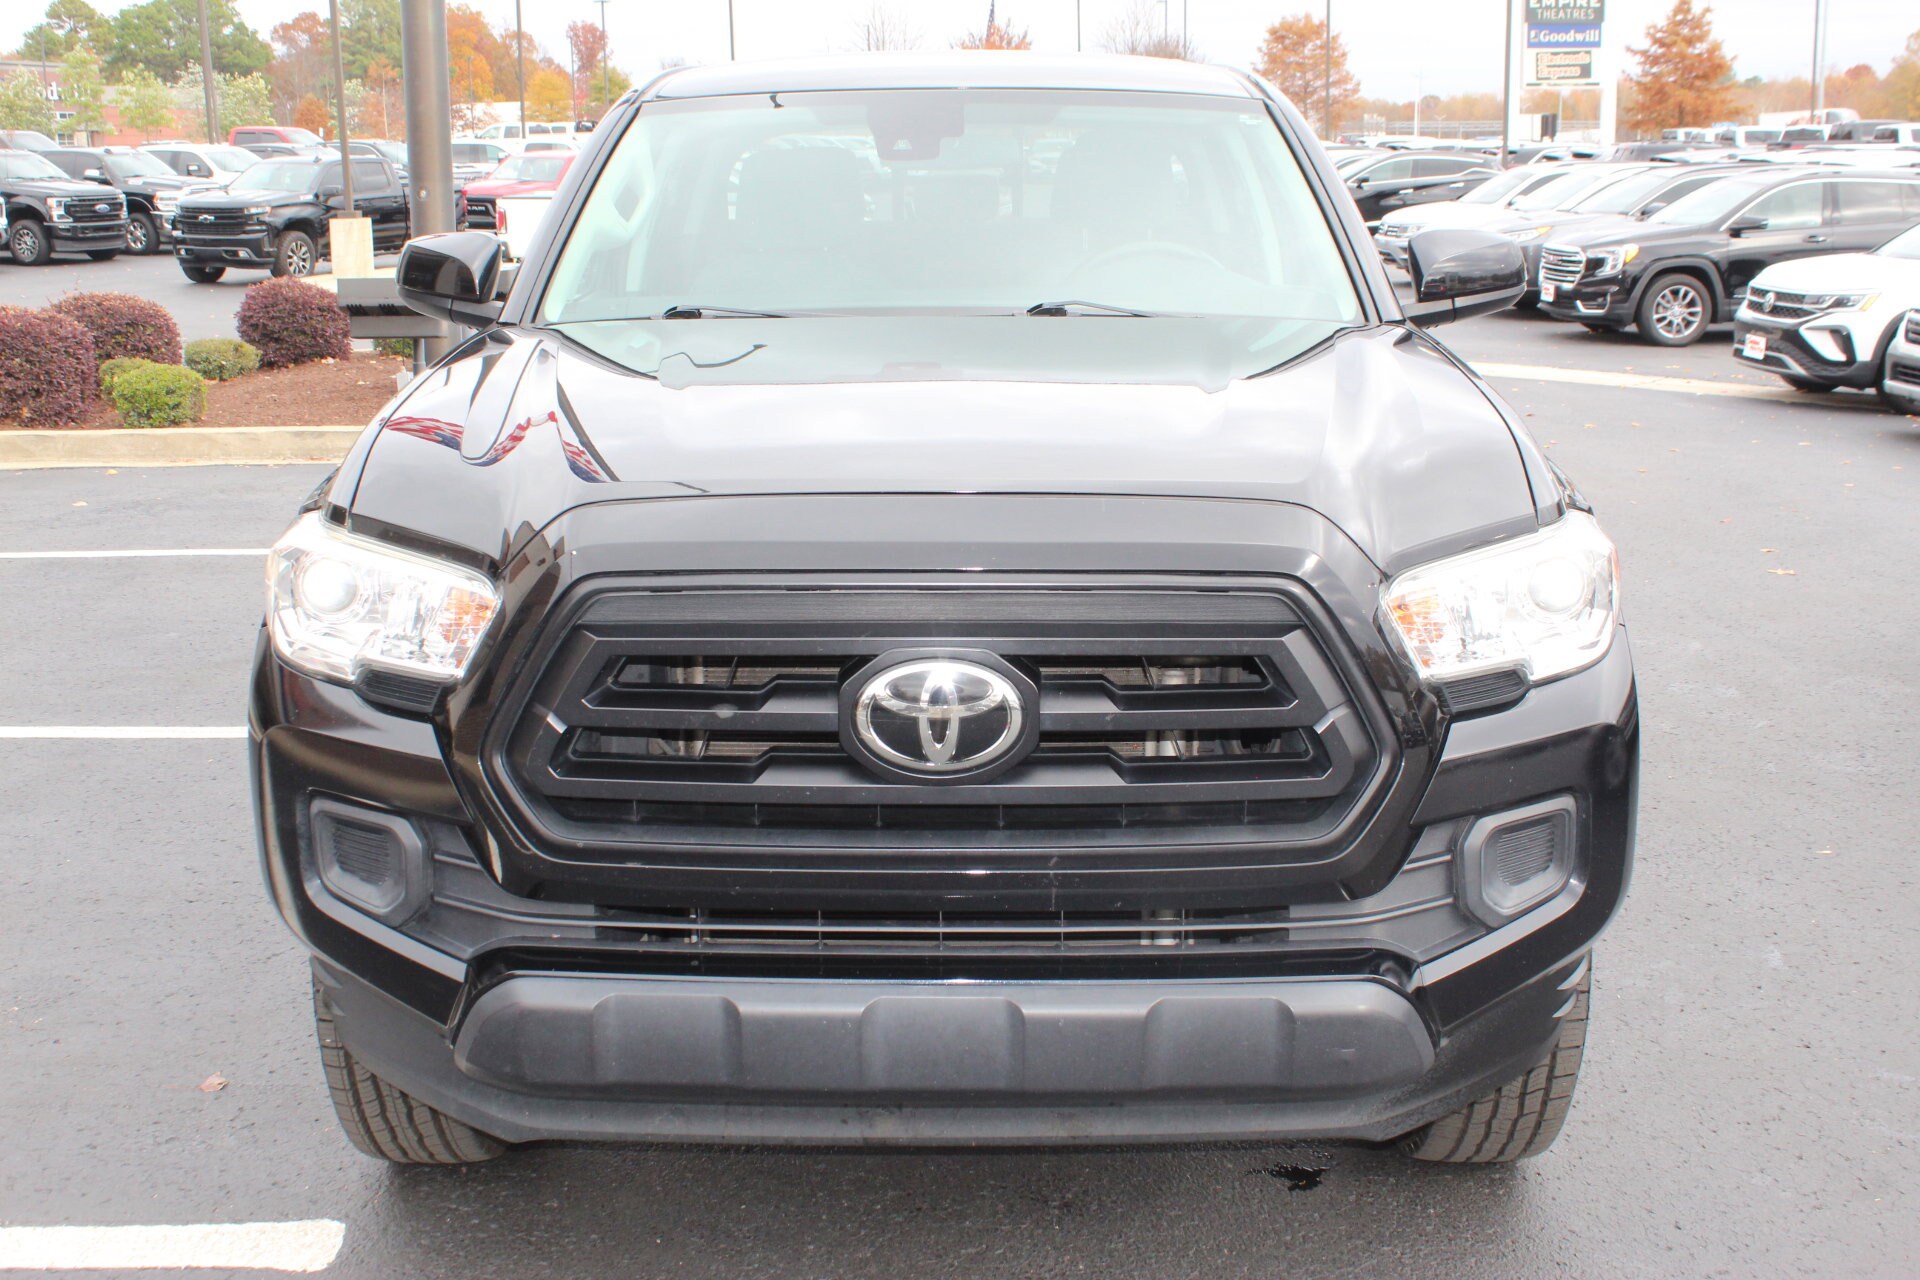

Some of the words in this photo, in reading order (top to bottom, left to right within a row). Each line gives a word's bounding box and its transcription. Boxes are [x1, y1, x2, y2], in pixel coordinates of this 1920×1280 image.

[1536, 8, 1595, 20] THEATRES
[1540, 28, 1600, 43] Goodwill
[1538, 52, 1590, 65] Electronic
[1538, 66, 1581, 79] Express
